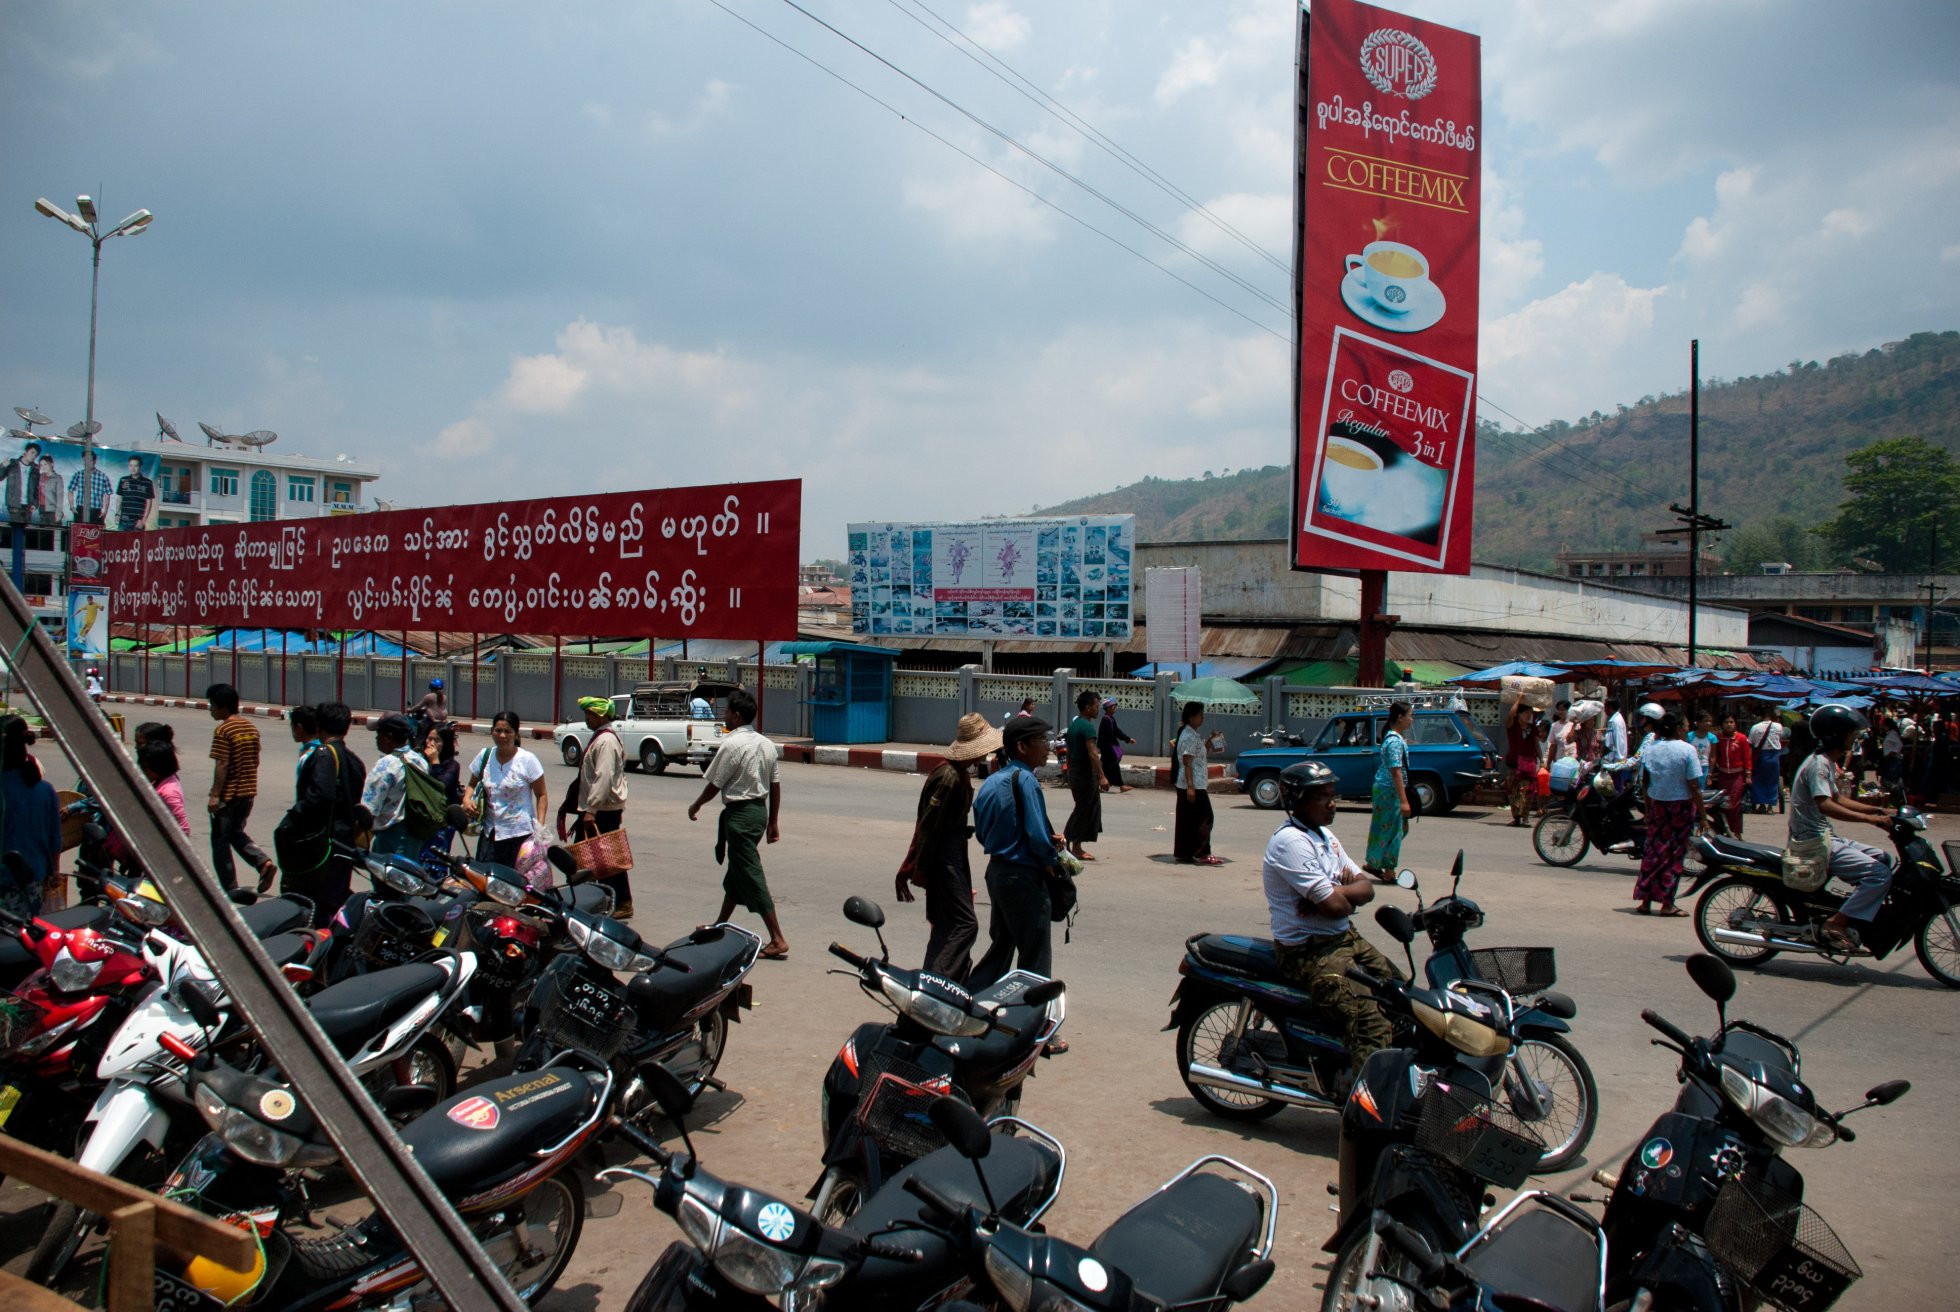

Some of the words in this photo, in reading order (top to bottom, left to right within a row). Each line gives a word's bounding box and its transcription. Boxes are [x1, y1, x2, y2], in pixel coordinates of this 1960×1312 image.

[1375, 45, 1425, 85] SUPER
[1326, 155, 1466, 207] COFFEEMIX
[1336, 408, 1391, 439] Regular
[1341, 378, 1451, 433] COFFEEMIX
[660, 494, 740, 556] မဟုတ်
[493, 1073, 562, 1103] Arsenal
